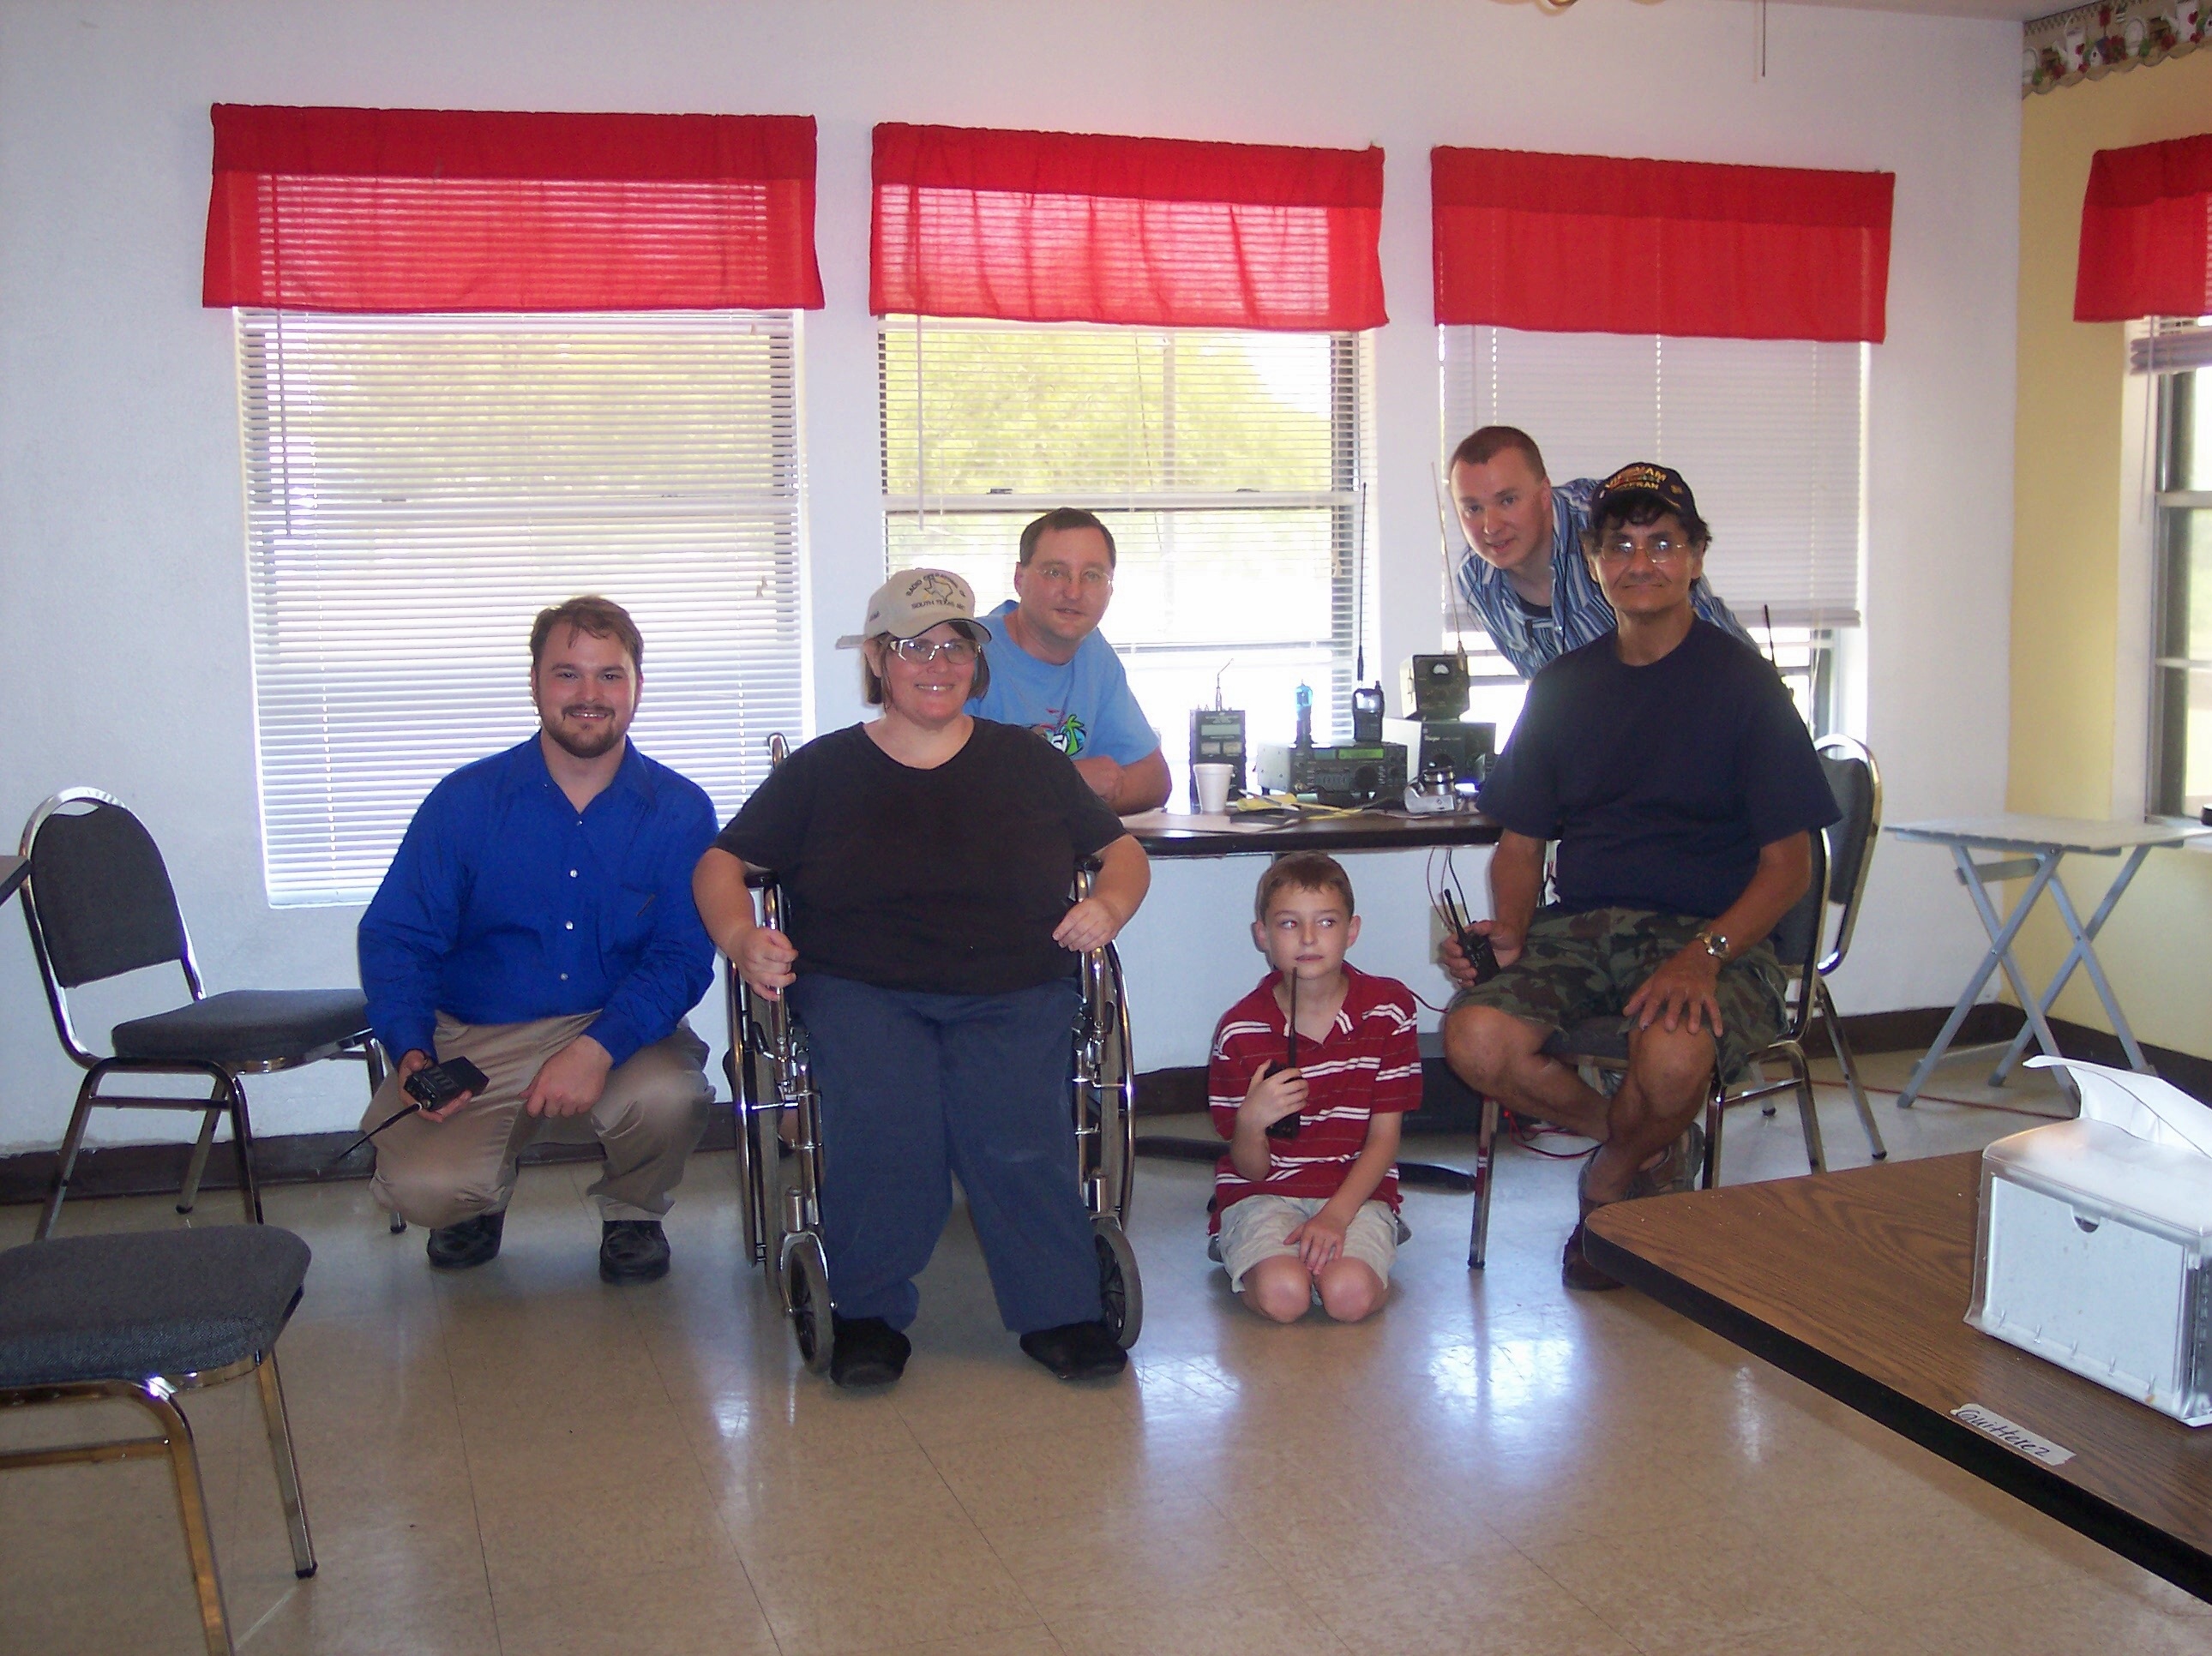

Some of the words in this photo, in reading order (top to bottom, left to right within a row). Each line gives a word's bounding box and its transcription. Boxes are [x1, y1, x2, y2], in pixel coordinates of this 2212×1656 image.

[1605, 465, 1668, 489] VIENAM
[911, 600, 935, 609] SOUTH
[935, 599, 955, 608] TEXAS
